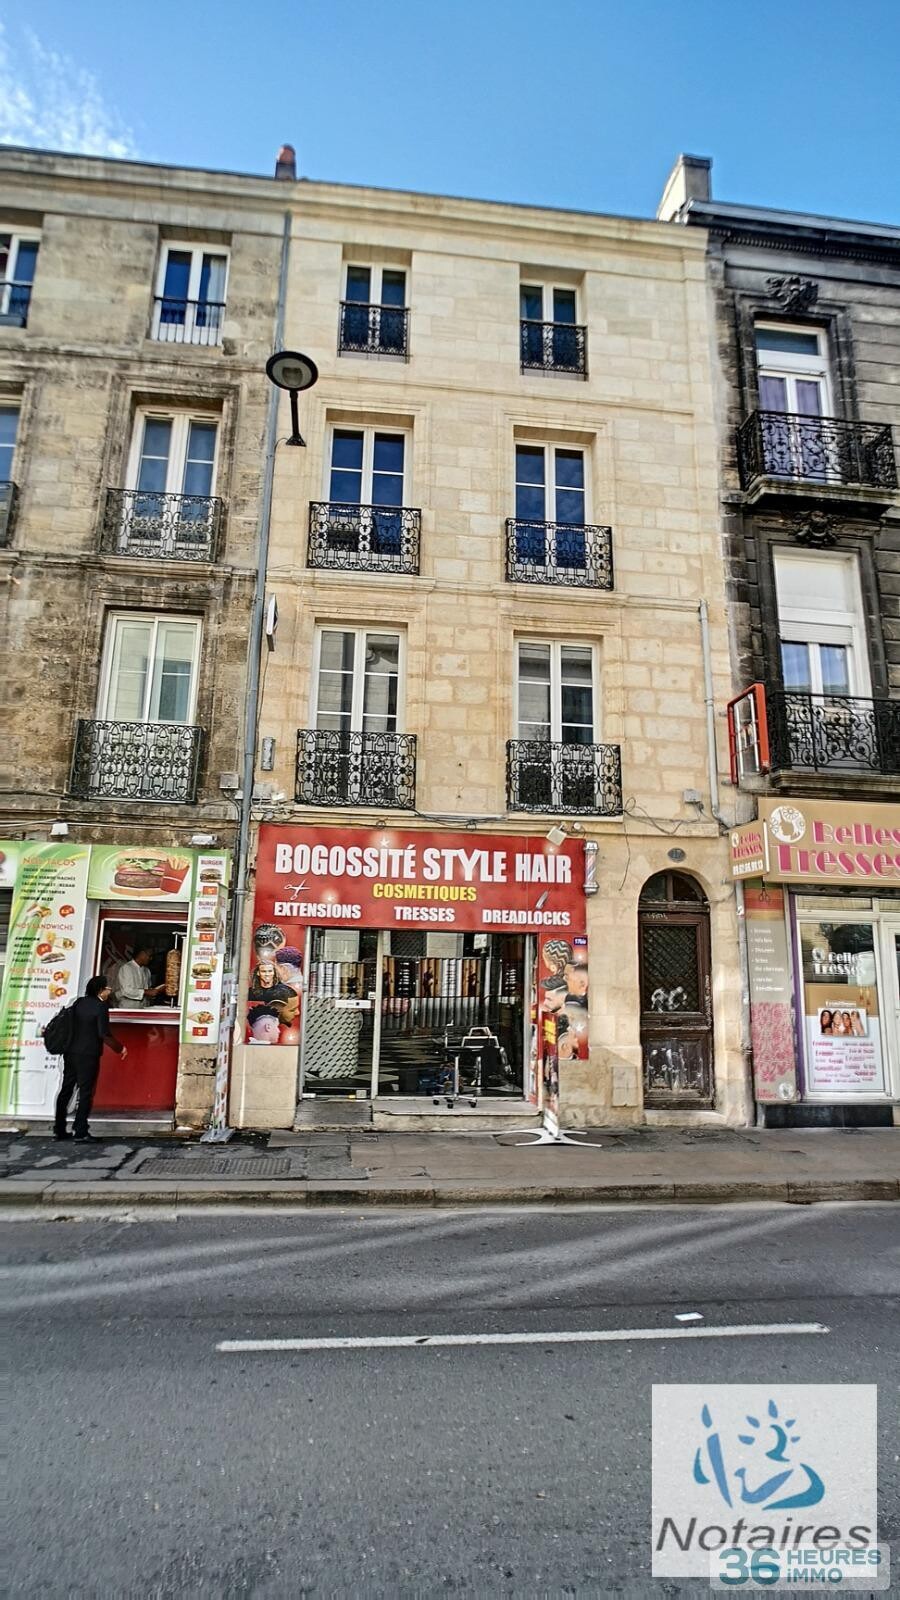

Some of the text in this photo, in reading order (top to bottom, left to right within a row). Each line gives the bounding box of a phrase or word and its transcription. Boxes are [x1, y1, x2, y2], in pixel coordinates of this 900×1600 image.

[275, 843, 572, 883] BOGOSSITÉ STYLE HAIR
[373, 883, 477, 902] COSMETIQUES
[274, 902, 362, 919] EXTENSIONS
[394, 906, 456, 923] TRESSES
[482, 909, 571, 926] DREADLOCKS
[32, 923, 74, 931] SANDWICHS
